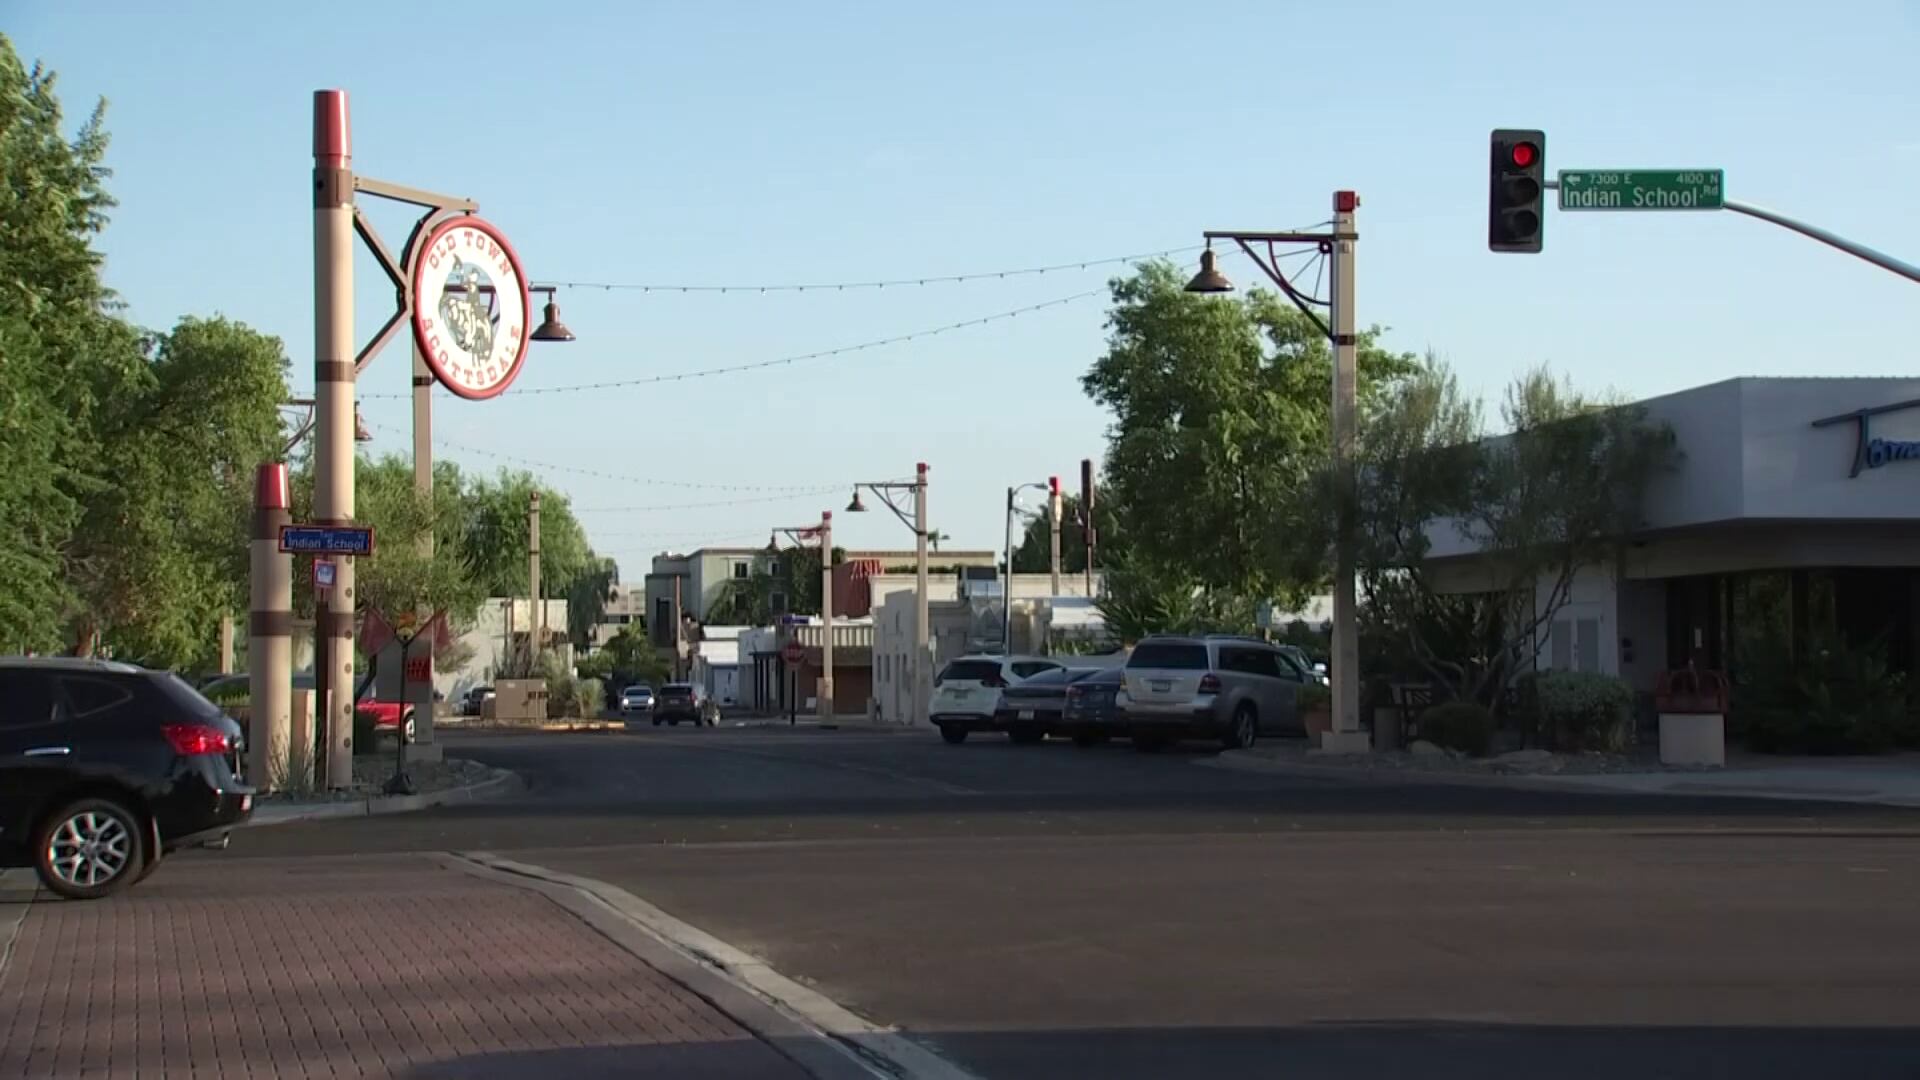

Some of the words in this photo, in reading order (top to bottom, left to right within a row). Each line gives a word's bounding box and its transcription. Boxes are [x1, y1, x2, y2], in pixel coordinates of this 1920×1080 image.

[1589, 173, 1618, 184] 7300
[1624, 173, 1632, 184] E
[1676, 173, 1704, 184] 4100
[1710, 173, 1718, 184] N
[1564, 187, 1621, 207] Indian
[1632, 187, 1697, 207] School
[1703, 185, 1719, 196] Rd
[429, 234, 456, 269] OLD
[463, 230, 512, 277] TOWN
[423, 318, 521, 386] SCOTTSDALE
[287, 534, 321, 548] Indian
[326, 536, 365, 551] School
